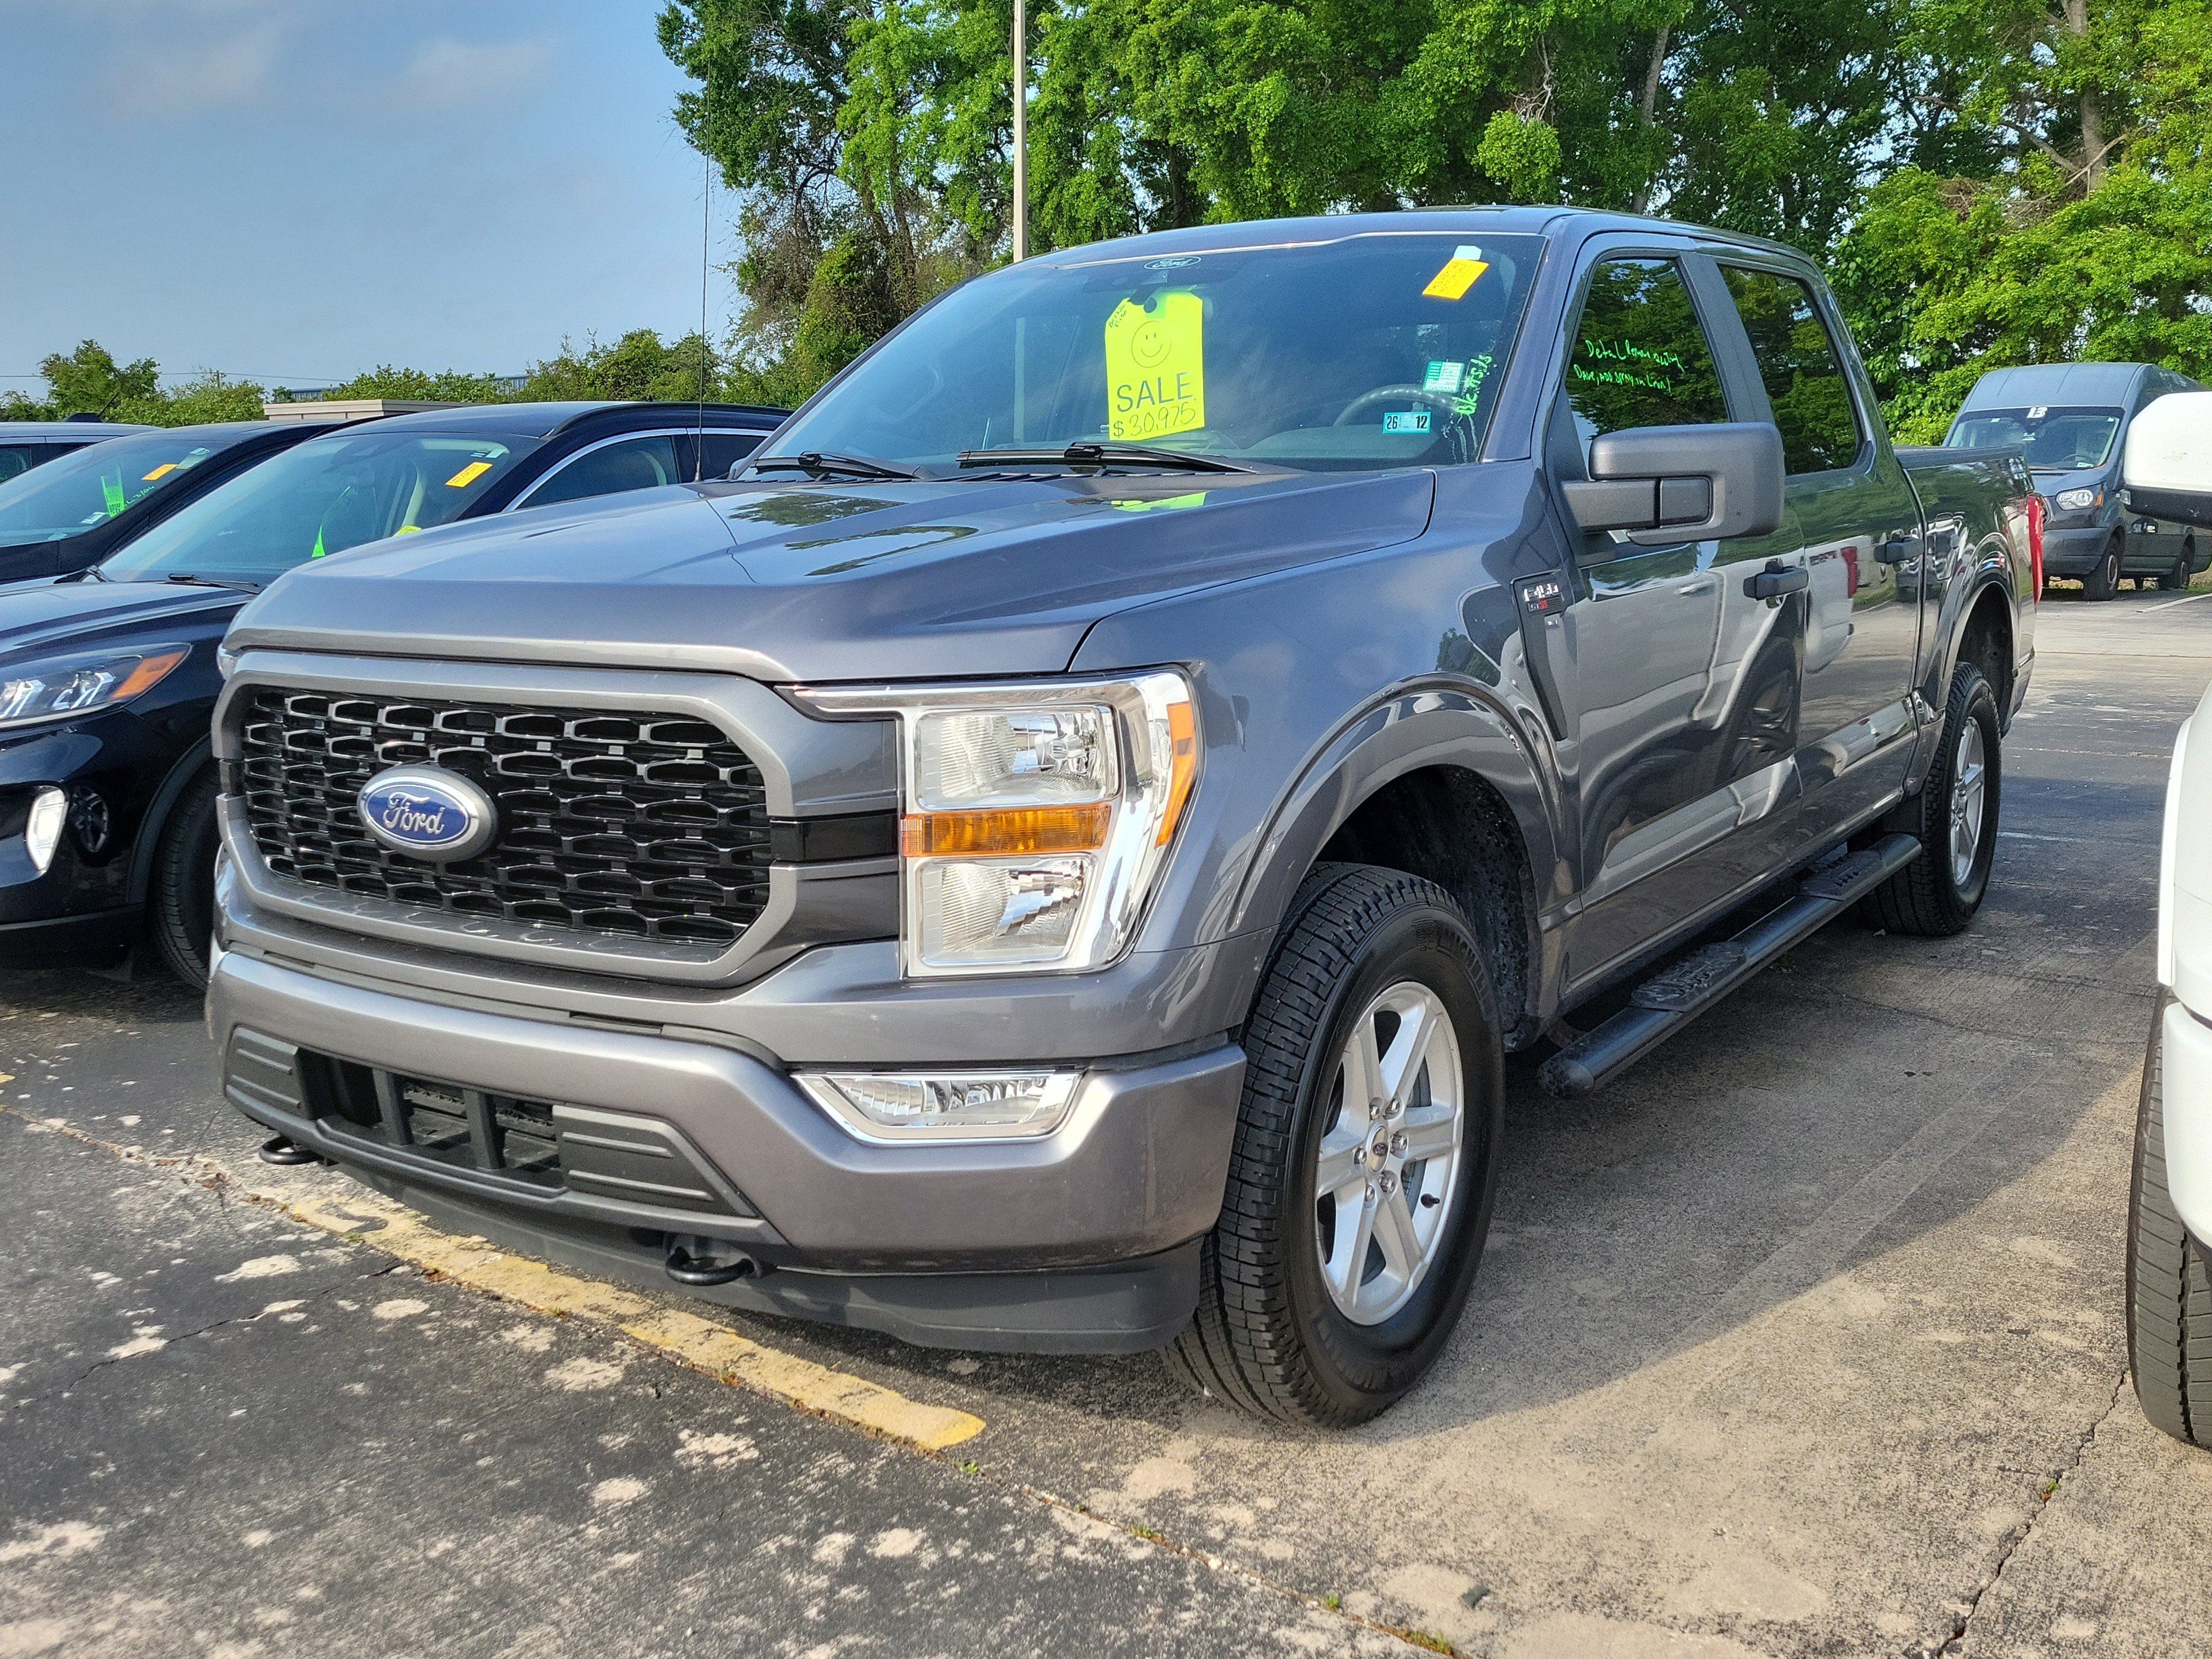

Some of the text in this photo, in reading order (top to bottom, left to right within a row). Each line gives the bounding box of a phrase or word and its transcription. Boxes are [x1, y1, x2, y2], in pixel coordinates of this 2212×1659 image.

[1152, 258, 1193, 268] Ford
[1117, 370, 1193, 412] SALE
[2027, 407, 2048, 419] 13
[1386, 415, 1398, 430] 26
[1415, 415, 1427, 429] 12
[382, 791, 445, 834] Ford
